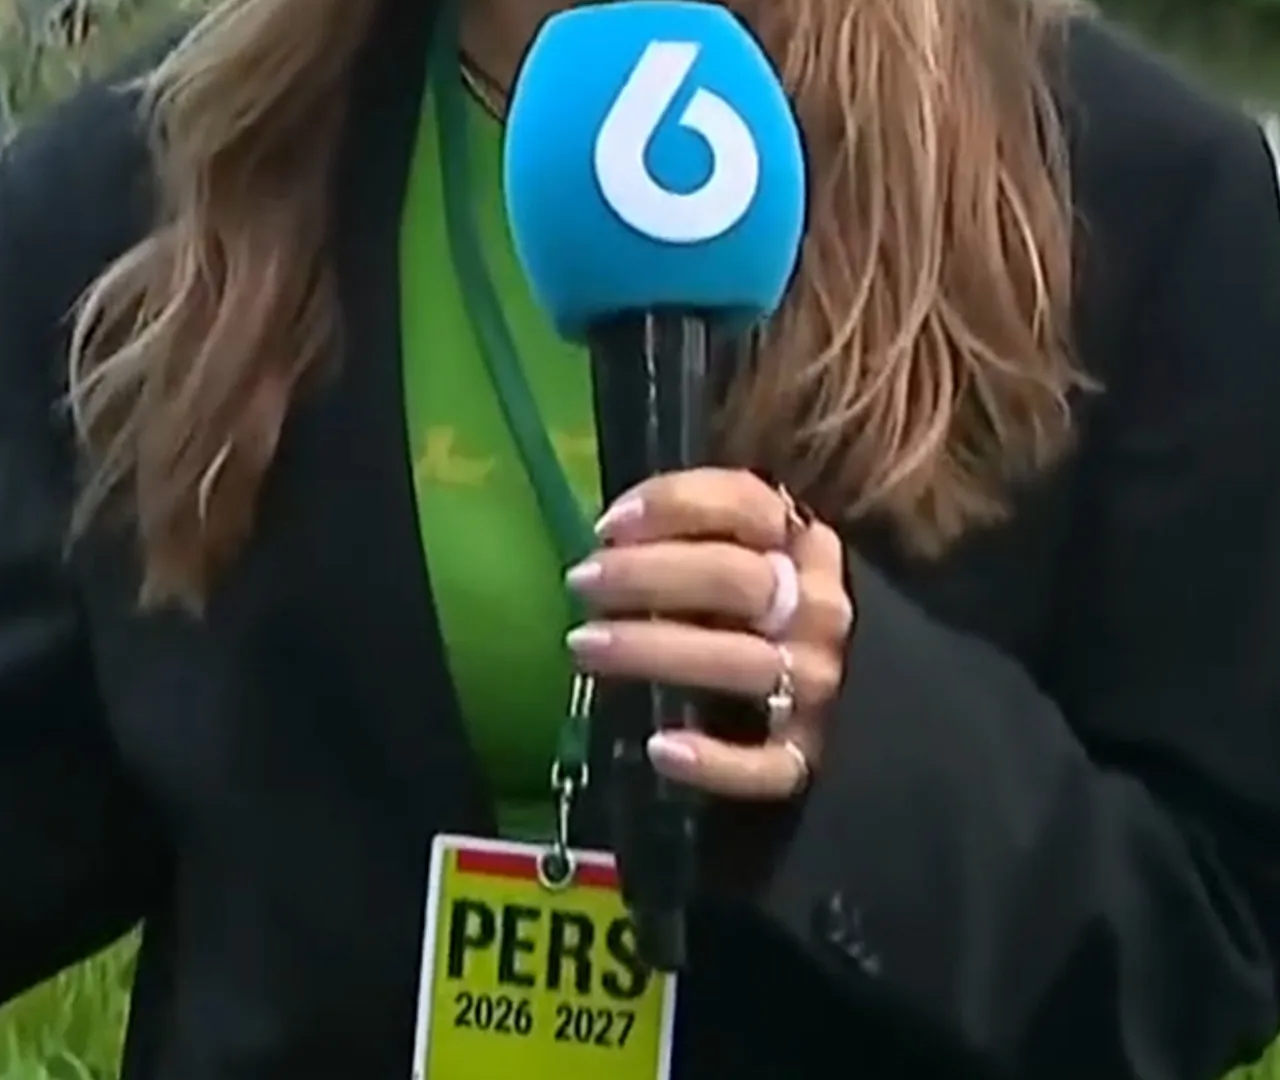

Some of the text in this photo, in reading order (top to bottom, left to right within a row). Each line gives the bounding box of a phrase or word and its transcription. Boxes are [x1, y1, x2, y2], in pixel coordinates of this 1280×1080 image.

[593, 37, 760, 245] 6
[446, 897, 651, 1001] PERS
[454, 991, 636, 1049] 2026 2027
